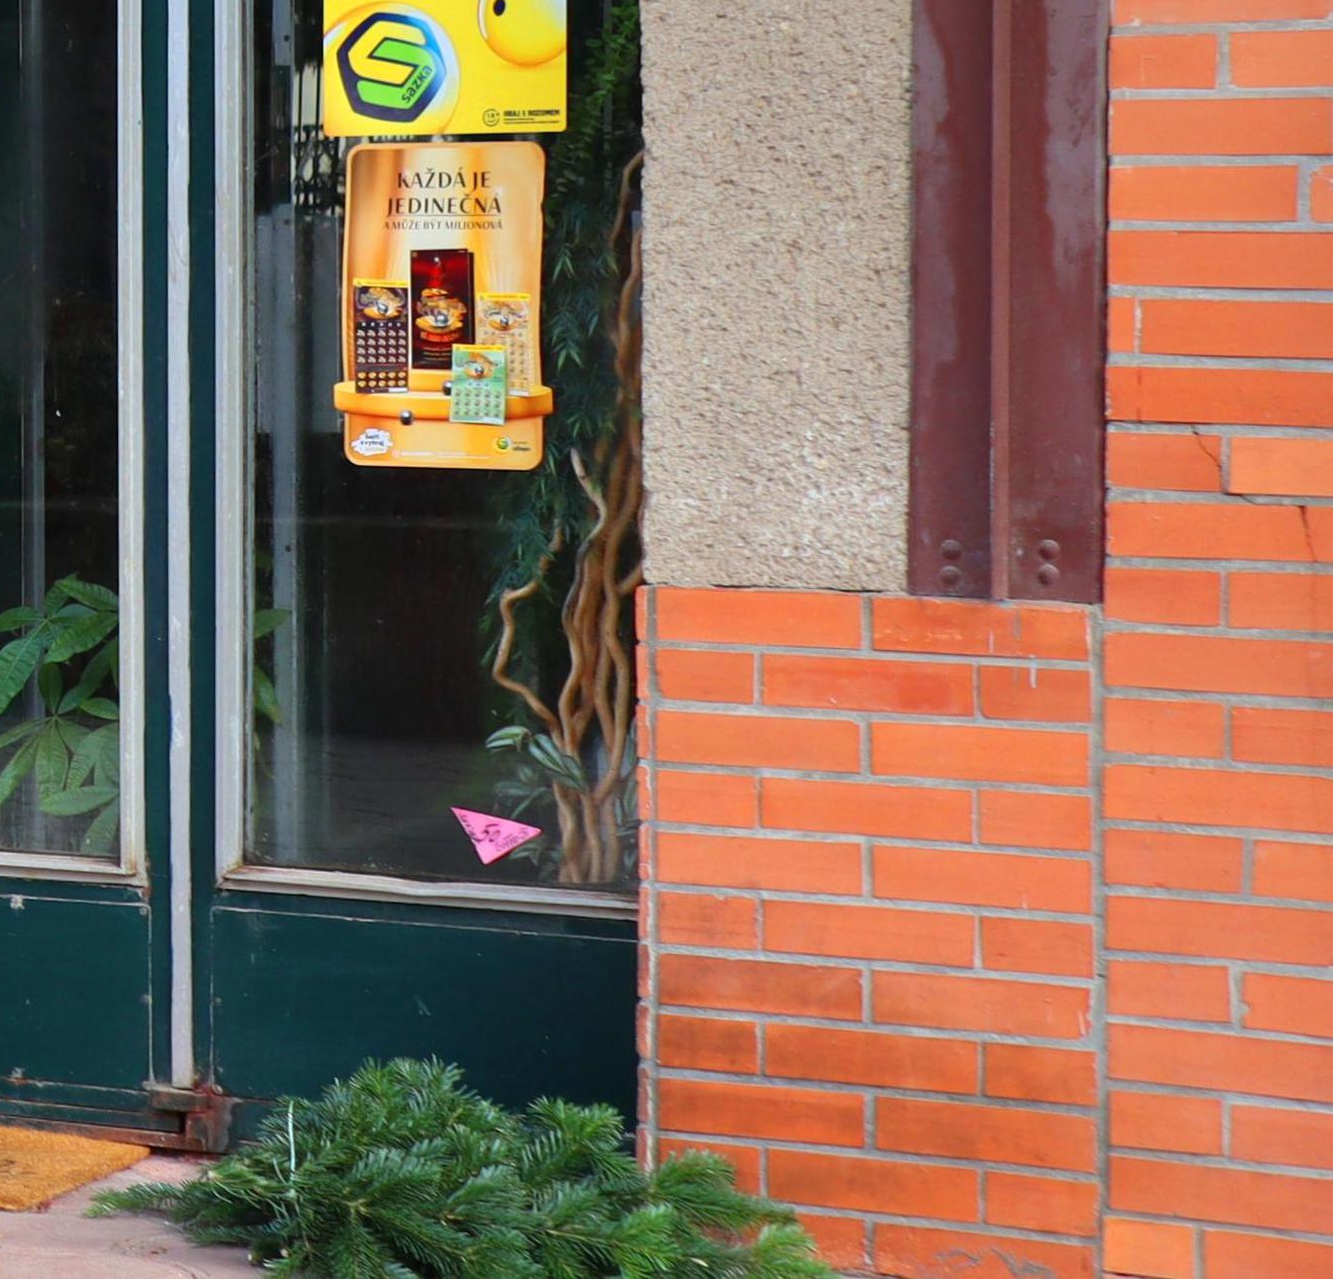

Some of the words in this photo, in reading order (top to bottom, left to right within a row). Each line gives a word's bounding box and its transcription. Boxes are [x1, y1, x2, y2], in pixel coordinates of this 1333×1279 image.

[401, 65, 433, 104] sazka
[397, 167, 467, 189] KAŽDÁ
[470, 171, 492, 192] JE
[387, 193, 502, 217] JEDINEČNÁ
